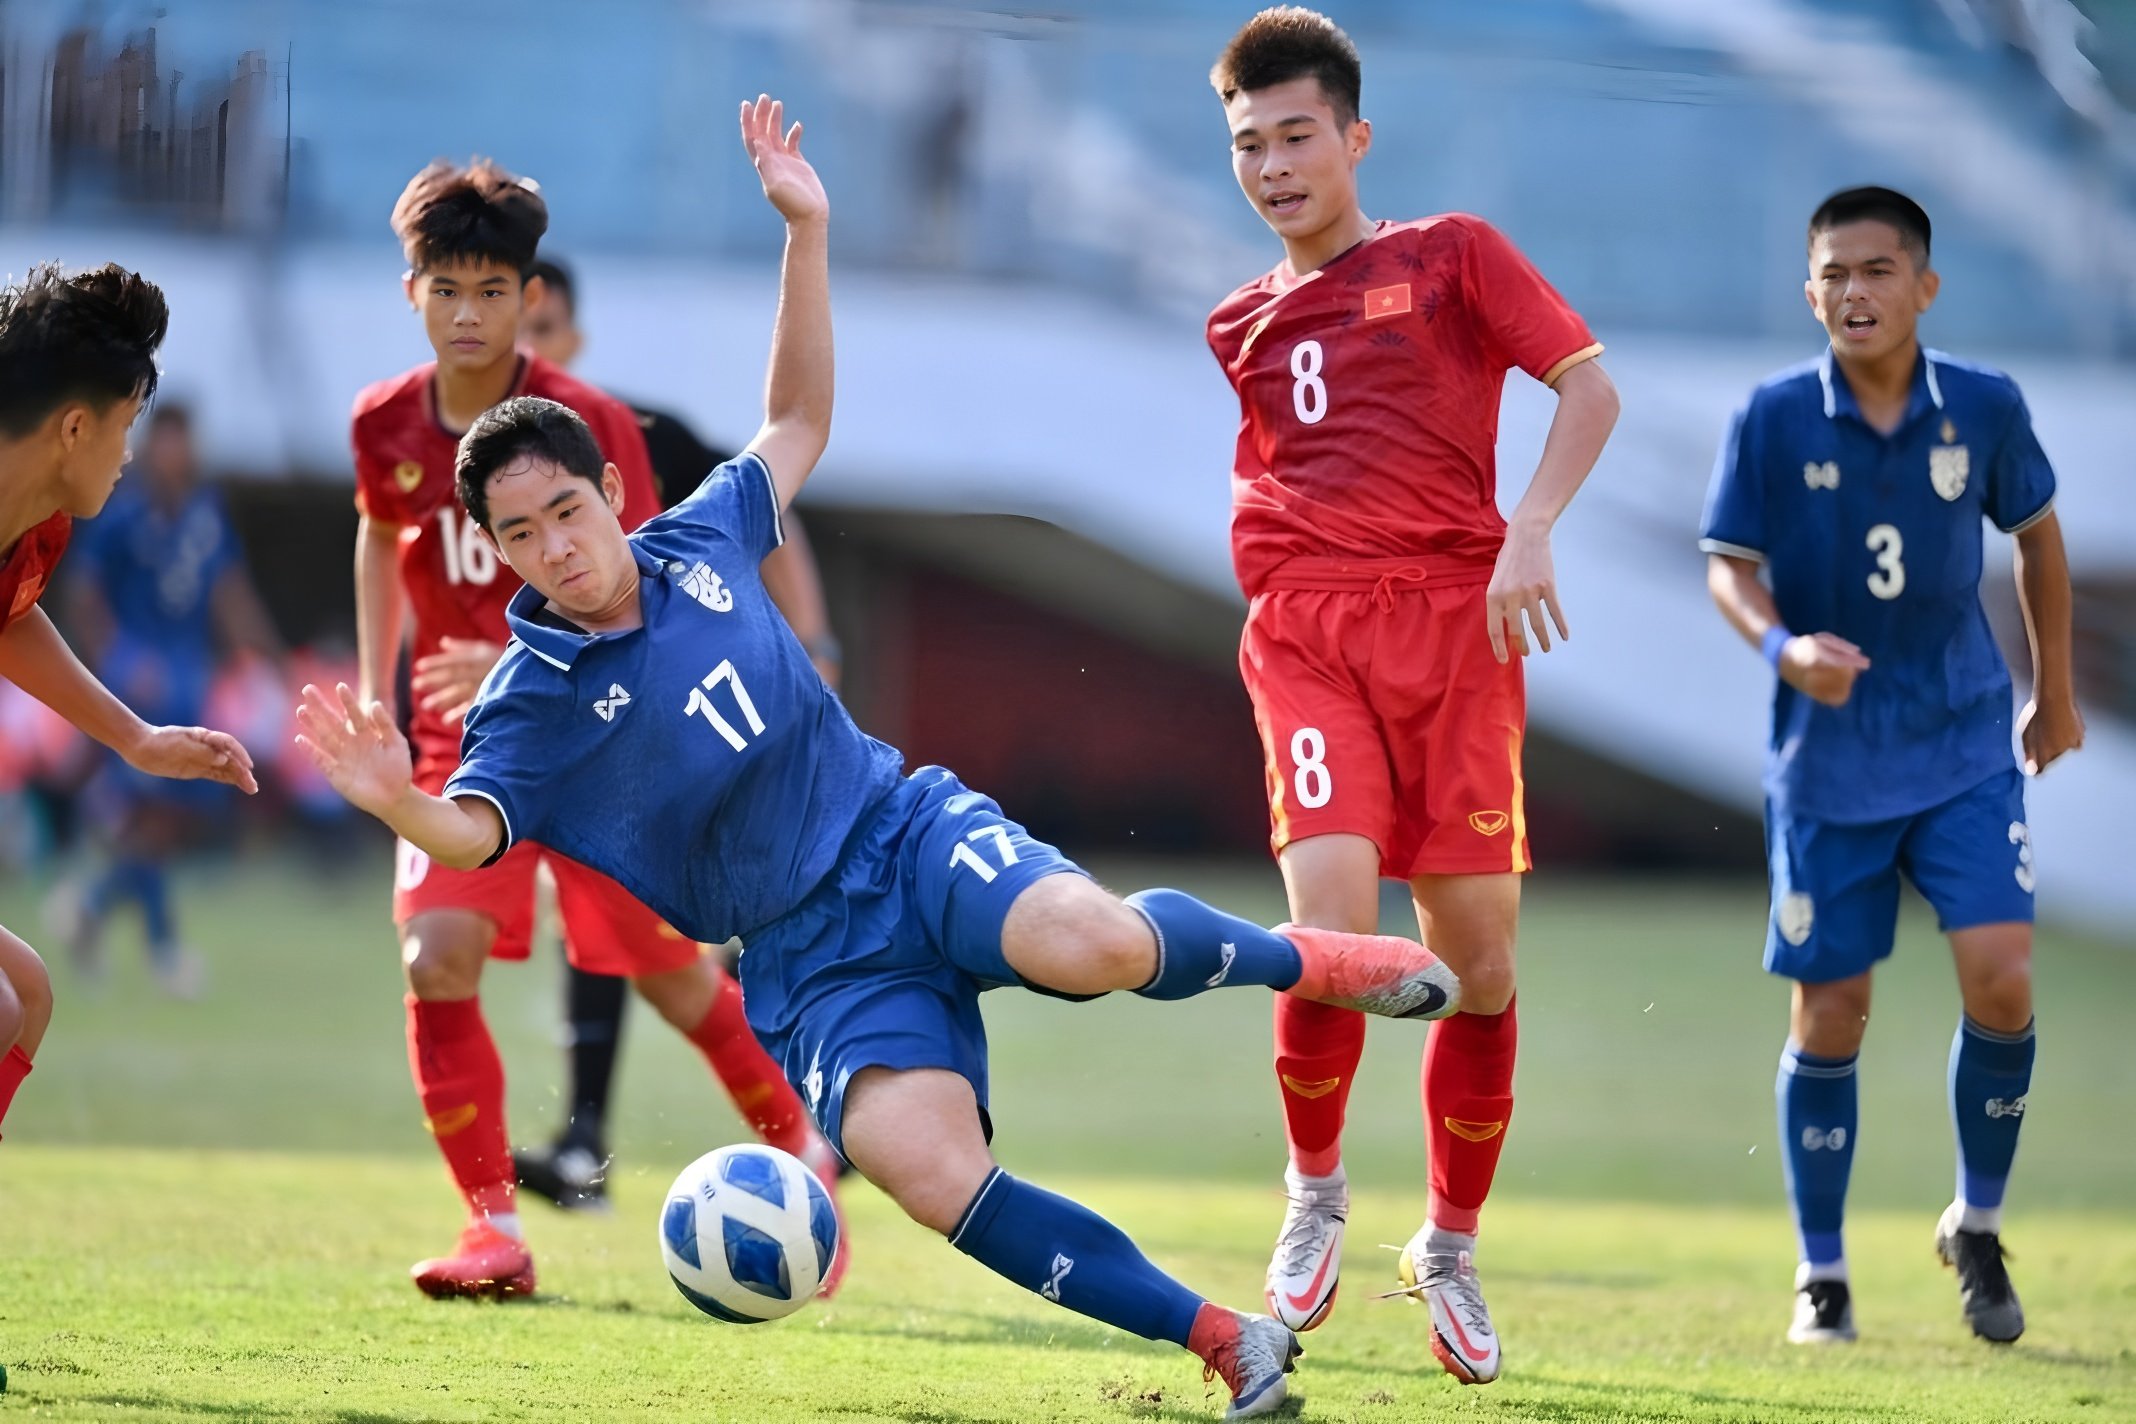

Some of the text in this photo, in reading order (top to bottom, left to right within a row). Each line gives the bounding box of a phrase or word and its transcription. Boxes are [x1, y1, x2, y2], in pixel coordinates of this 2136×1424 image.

[1291, 340, 1328, 425] 8
[437, 505, 497, 586] 16
[1865, 523, 1905, 600] 3
[683, 658, 766, 752] 17
[1290, 727, 1332, 809] 8
[948, 824, 1020, 884] 17
[2008, 821, 2034, 894] 3
